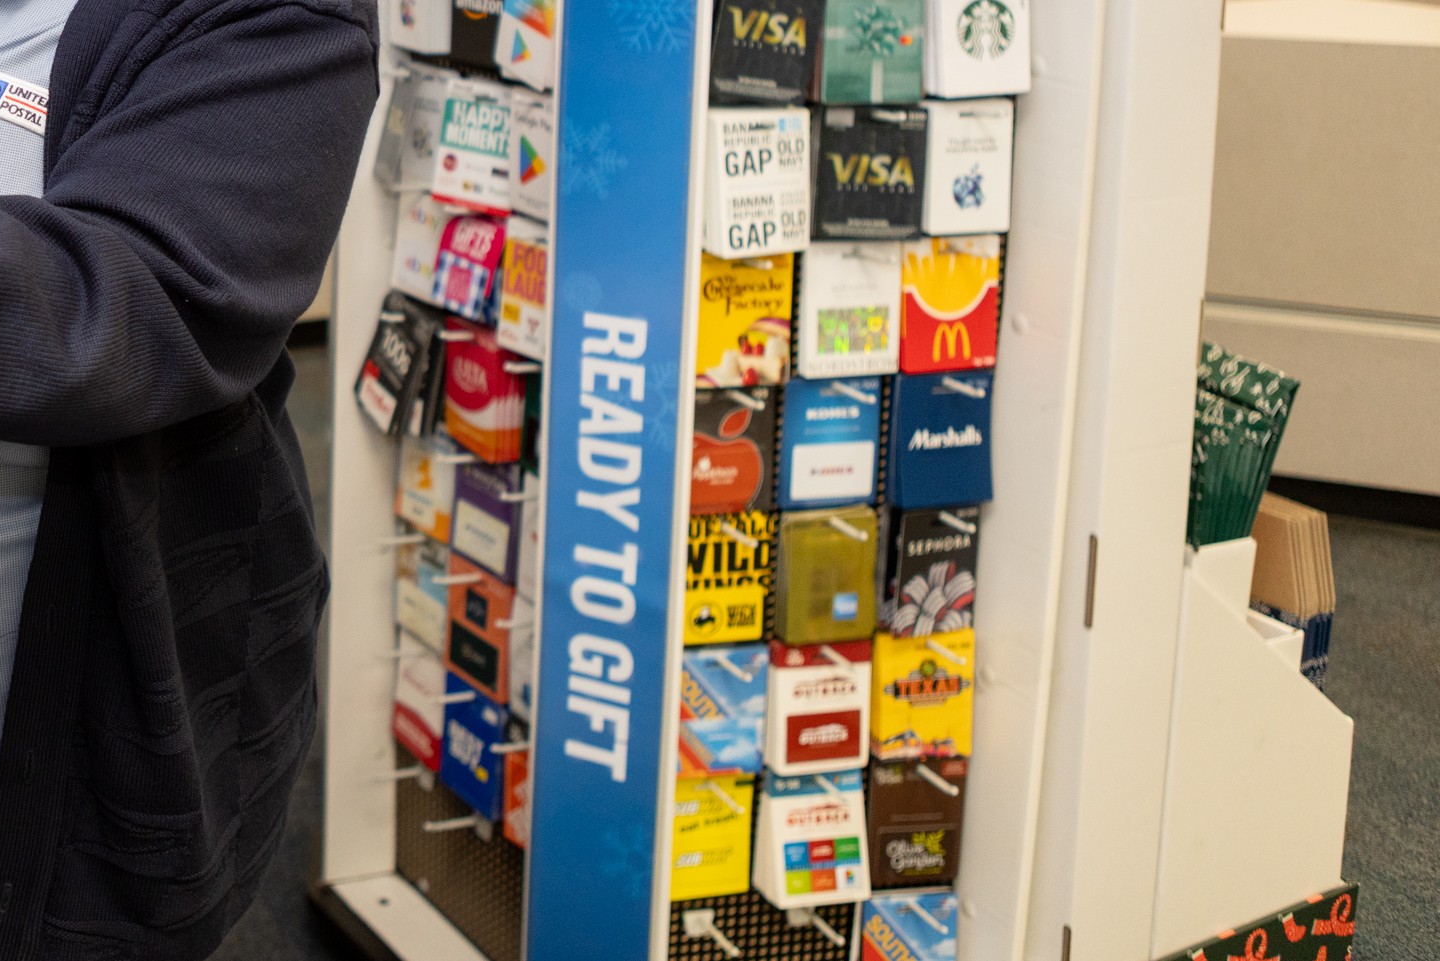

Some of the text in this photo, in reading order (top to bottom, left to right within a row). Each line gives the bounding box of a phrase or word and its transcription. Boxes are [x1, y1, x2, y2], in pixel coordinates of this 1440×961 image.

[727, 6, 807, 50] VISA
[8, 83, 48, 108] UNITE
[0, 100, 42, 127] POSTAL
[723, 120, 774, 136] BAN
[723, 134, 771, 147] REPUBLIC
[777, 138, 805, 156] OLD
[724, 148, 773, 178] GAP
[778, 155, 804, 169] NAVY
[827, 151, 915, 187] VISA
[732, 195, 775, 210] BANANA
[732, 208, 775, 221] REPUBLIC
[781, 210, 806, 227] OLD
[728, 221, 776, 251] GAP
[782, 226, 806, 240] NAVY
[513, 240, 547, 276] FOO
[503, 268, 547, 306] LAUG
[703, 276, 784, 303] Cheesecake
[724, 297, 784, 317] Factory
[908, 425, 982, 451] Marshalls
[563, 311, 649, 784] READY TO GIFT
[907, 534, 972, 557] SEPHORA
[793, 683, 857, 699] OUTBACK
[896, 675, 959, 698] TEXAS
[786, 810, 851, 827] OUTBACK
[885, 839, 926, 858] Olive
[889, 853, 946, 873] Garden
